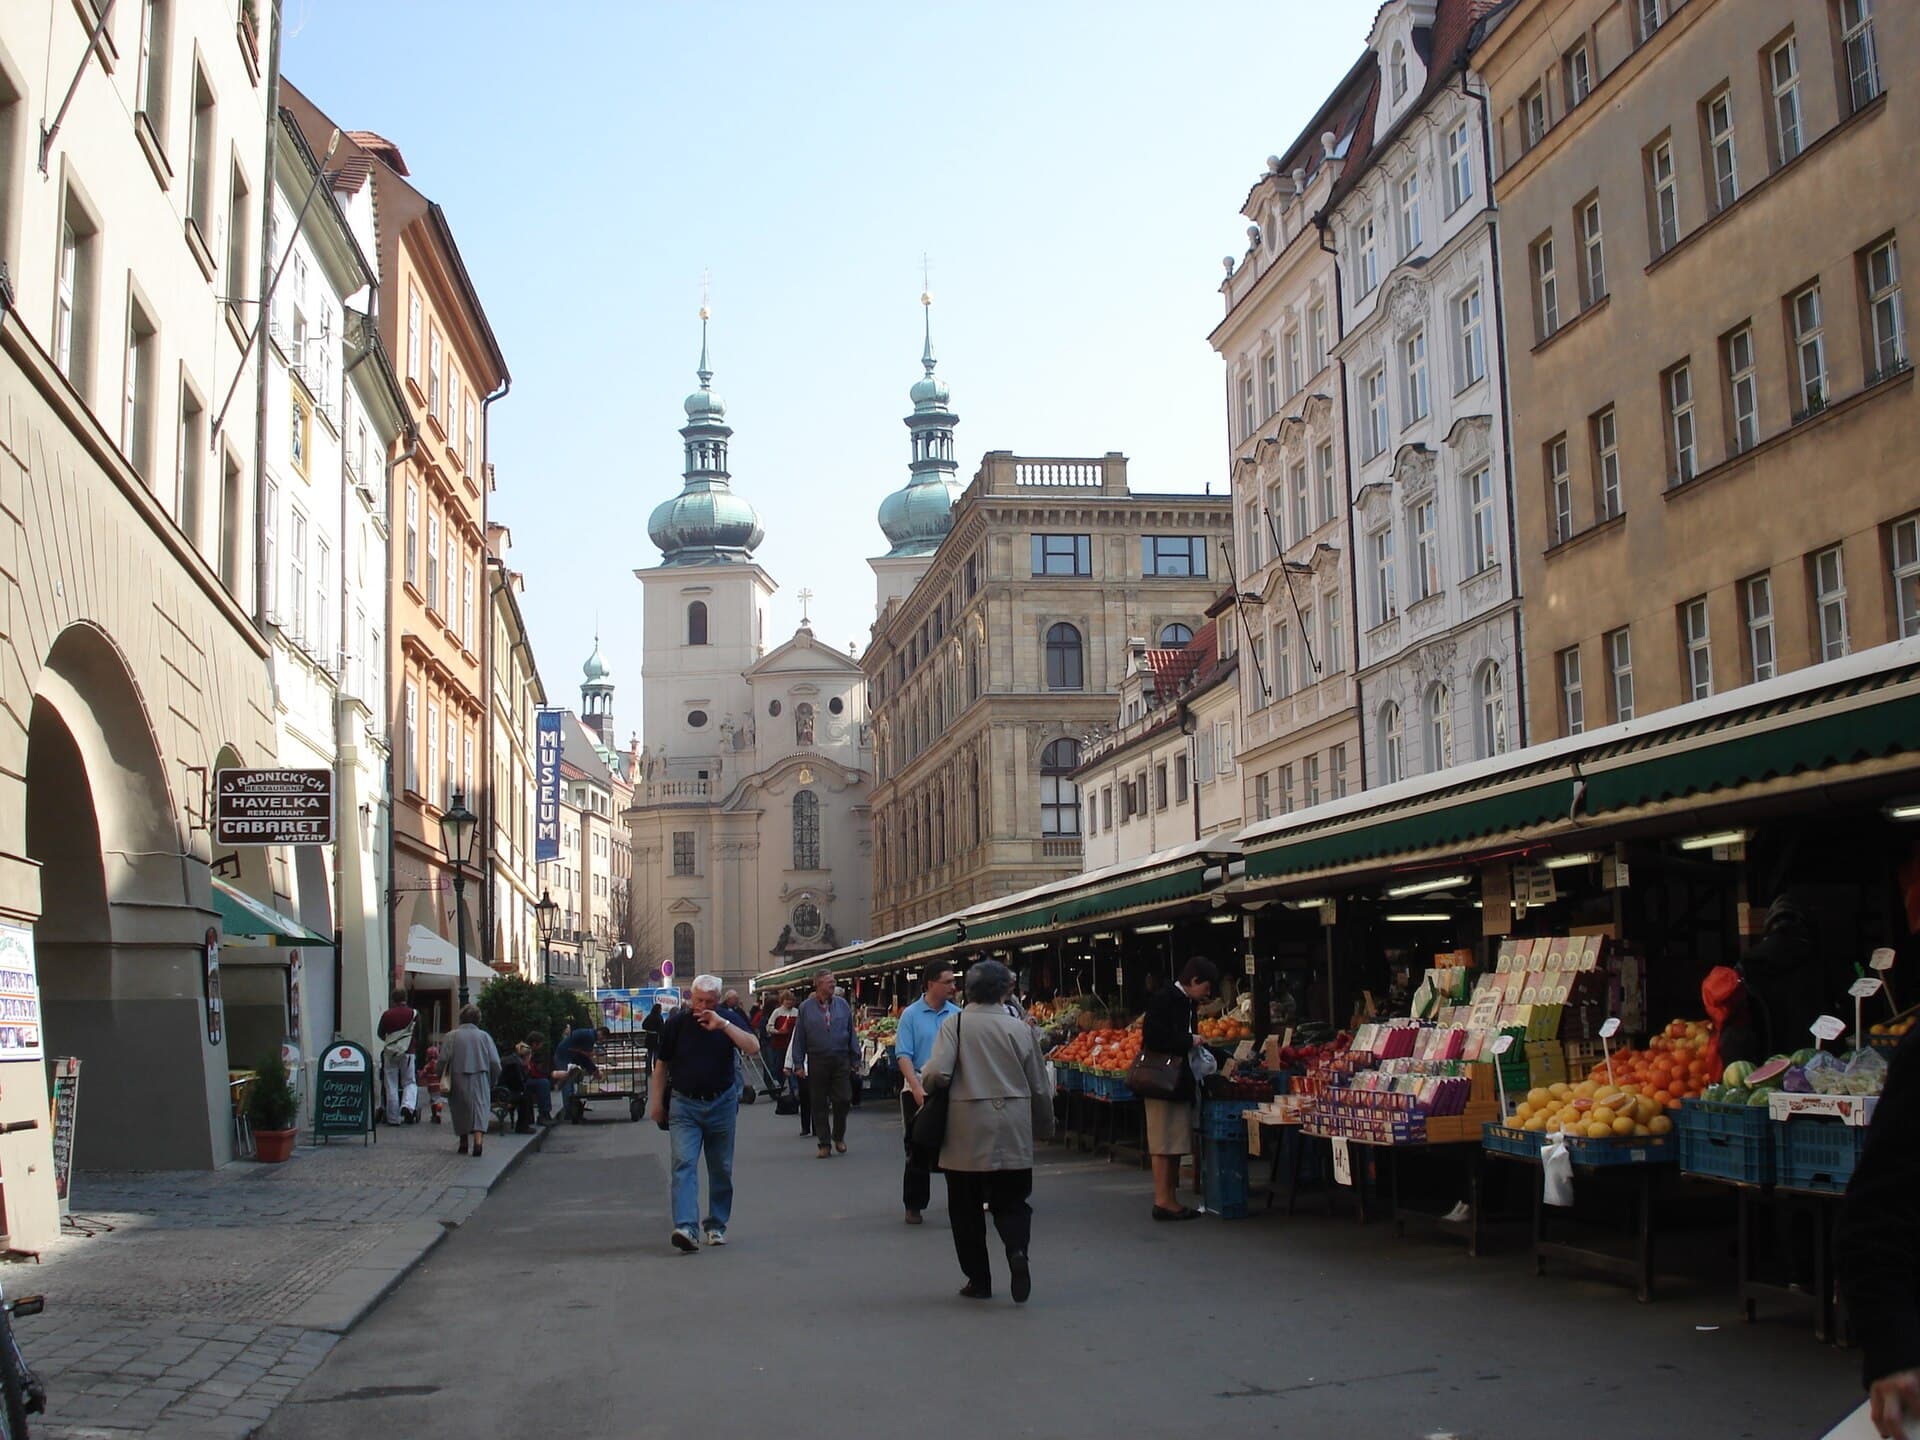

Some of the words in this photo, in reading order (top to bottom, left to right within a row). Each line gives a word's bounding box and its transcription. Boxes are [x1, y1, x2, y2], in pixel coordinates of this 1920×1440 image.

[224, 782, 235, 792] U
[237, 772, 325, 792] RADNICKÝCH
[538, 731, 558, 840] MUSEUM
[232, 797, 320, 808] HAVELKA
[222, 821, 322, 833] CABARET
[323, 1095, 362, 1108] CZECH
